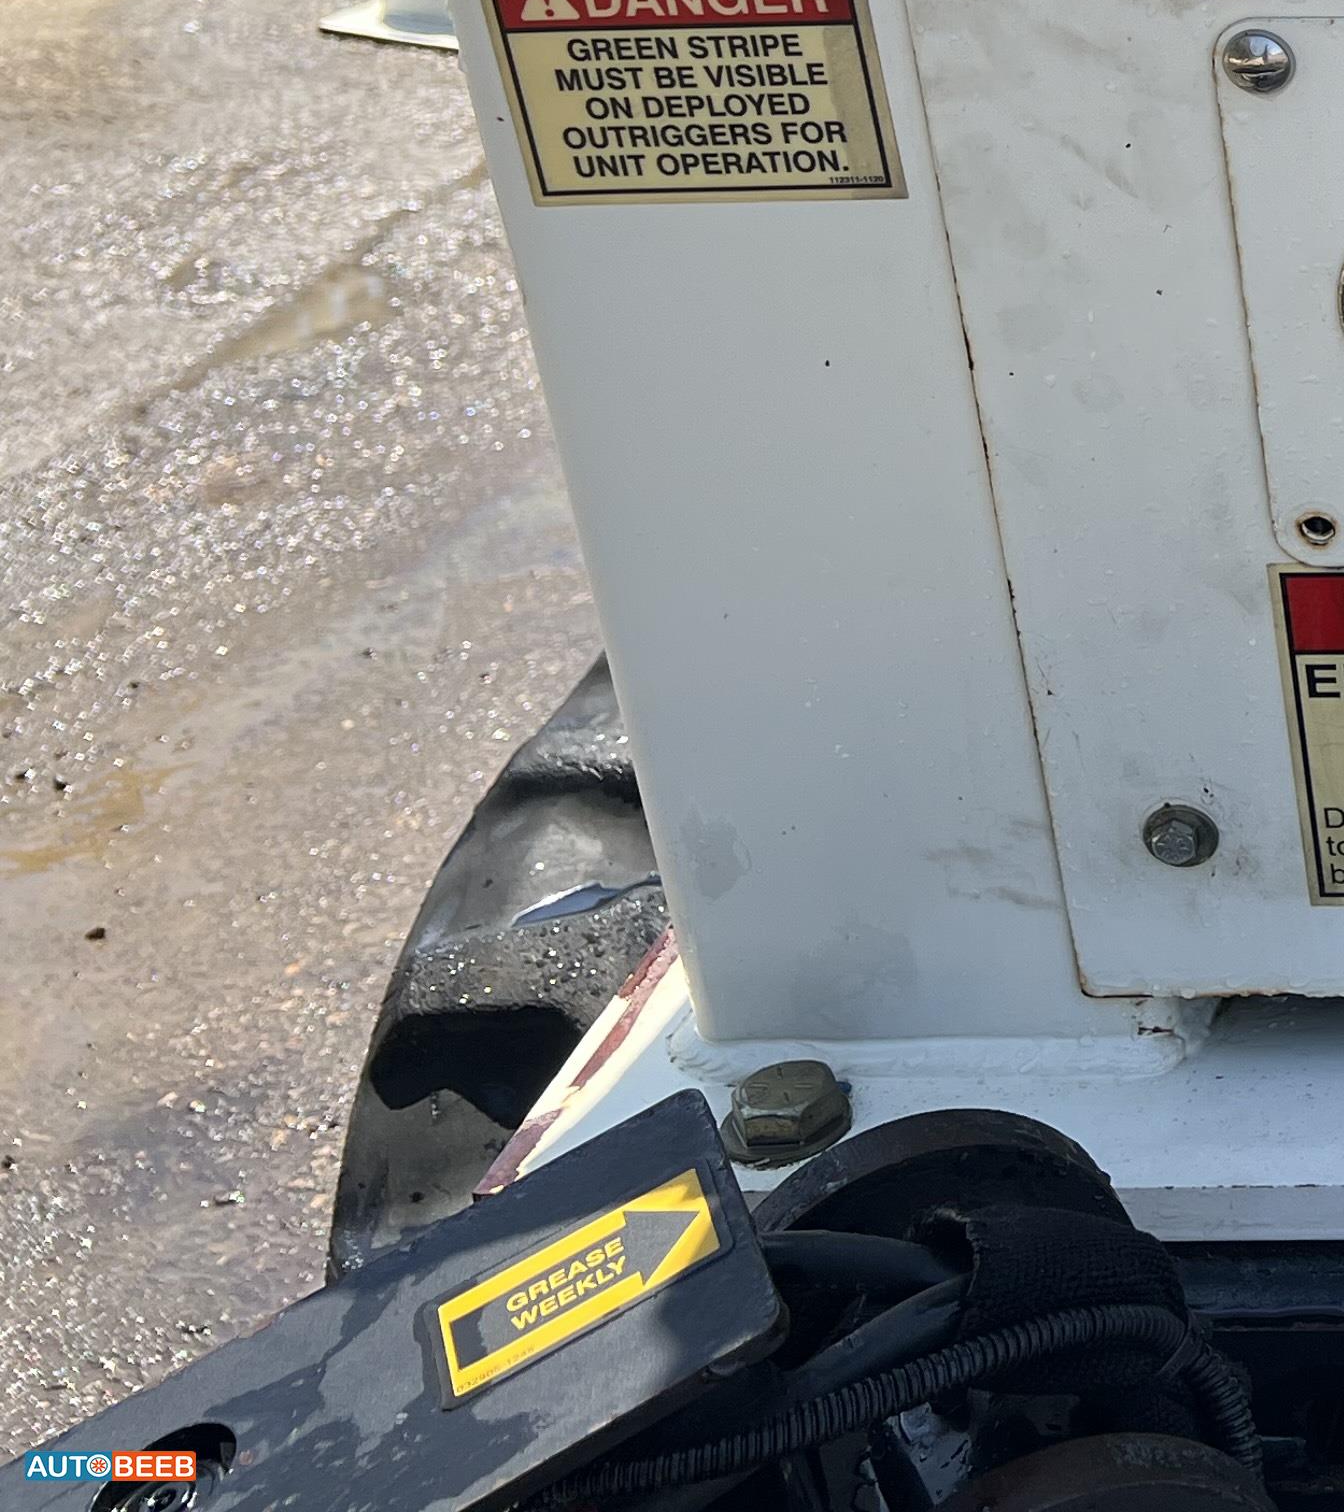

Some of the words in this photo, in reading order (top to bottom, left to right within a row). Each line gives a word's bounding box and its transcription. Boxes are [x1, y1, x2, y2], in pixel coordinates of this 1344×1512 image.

[567, 36, 678, 61] GREEN
[687, 33, 802, 58] STRIPE
[554, 66, 643, 91] MUST
[653, 65, 697, 88] BE
[702, 62, 828, 87] VISIBLE
[585, 96, 633, 119] ON
[641, 92, 810, 118] DEPLOYED
[562, 122, 772, 149] OUTRIGGERS
[780, 120, 847, 143] FOR
[572, 154, 645, 177] UNIT
[656, 149, 849, 175] OPERATION.
[506, 1237, 624, 1312] GREASE
[510, 1256, 626, 1330] WEEKLY
